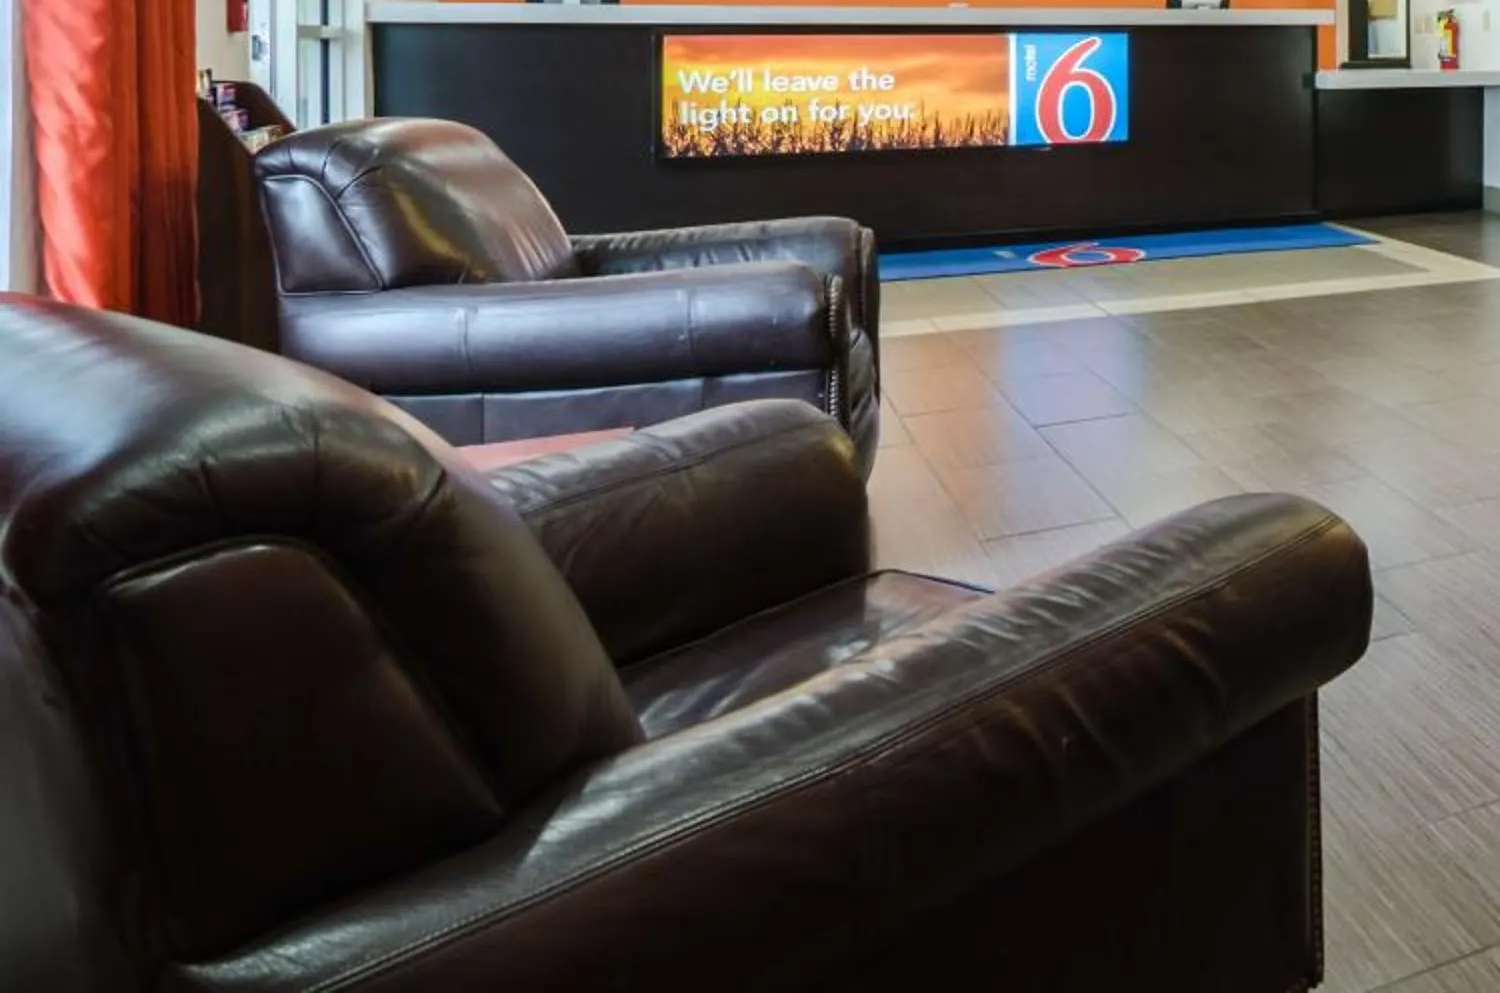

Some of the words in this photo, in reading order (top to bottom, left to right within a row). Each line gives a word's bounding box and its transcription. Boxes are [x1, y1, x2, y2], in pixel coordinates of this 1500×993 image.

[678, 69, 753, 94] We'll
[764, 67, 839, 93] leave
[848, 66, 896, 92] the
[1036, 36, 1117, 144] 6
[679, 99, 752, 132] light
[761, 105, 799, 124] on
[808, 98, 848, 122] for
